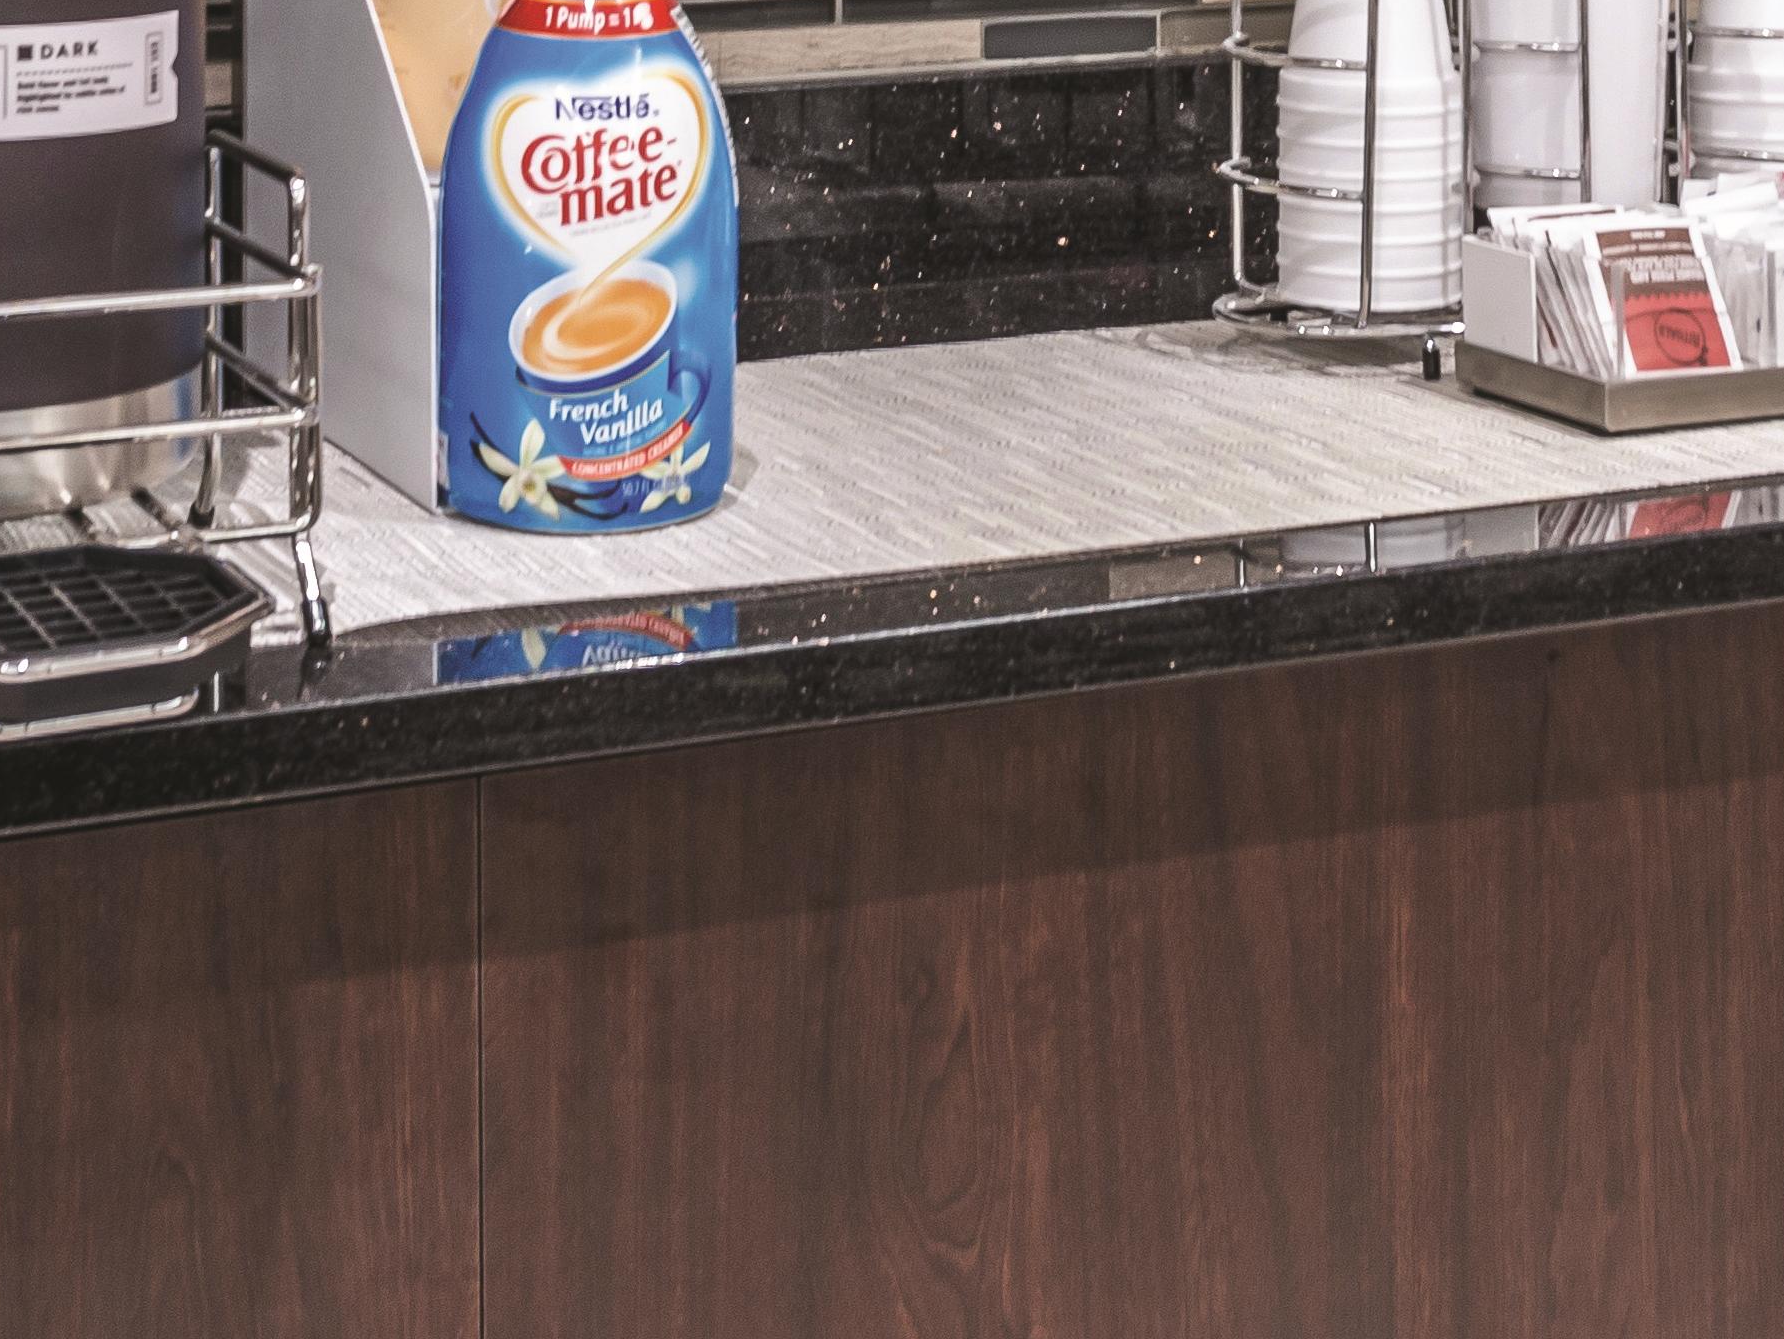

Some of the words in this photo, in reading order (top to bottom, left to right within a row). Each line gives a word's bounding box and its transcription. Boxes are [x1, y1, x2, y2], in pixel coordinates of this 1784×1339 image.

[546, 5, 553, 27] 1
[557, 6, 605, 35] Pump
[623, 7, 630, 27] 1
[41, 40, 99, 60] DARK
[555, 93, 650, 120] Nestlé
[560, 164, 678, 226] mate
[550, 389, 629, 421] French
[580, 397, 664, 445] Vanilla
